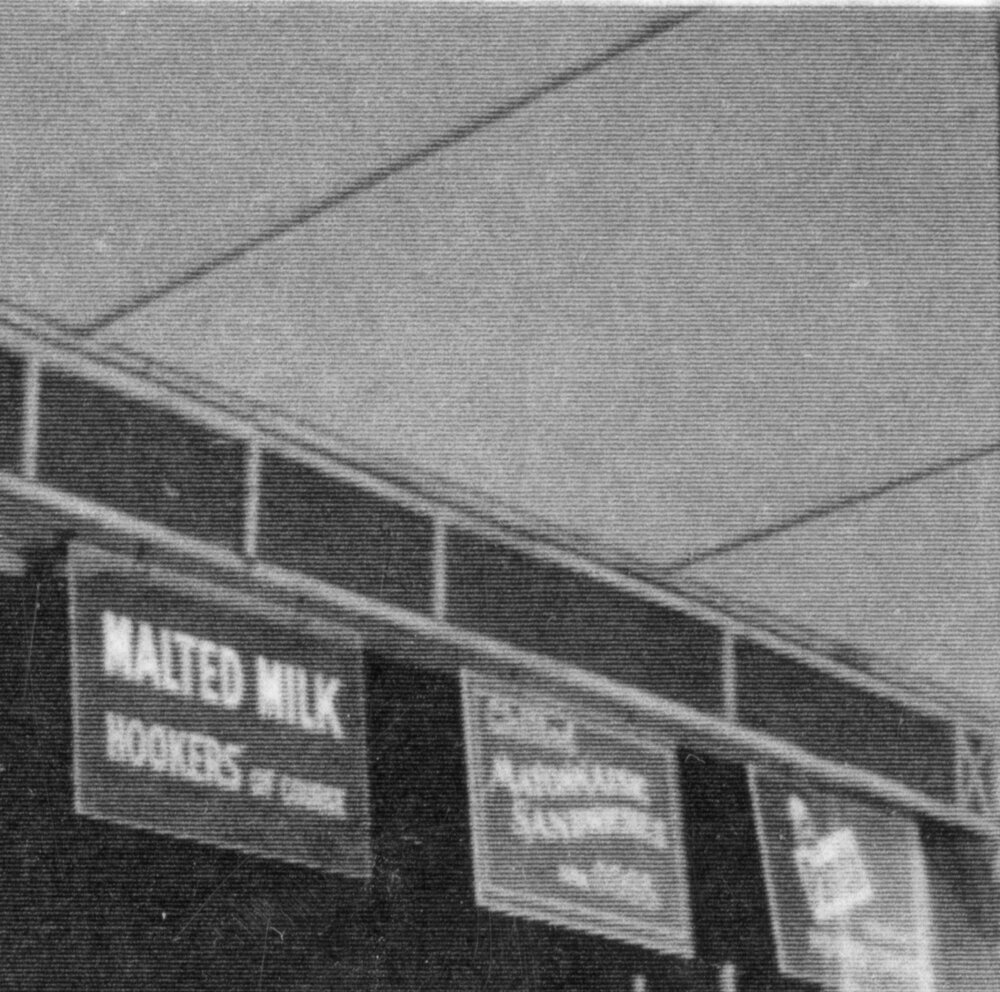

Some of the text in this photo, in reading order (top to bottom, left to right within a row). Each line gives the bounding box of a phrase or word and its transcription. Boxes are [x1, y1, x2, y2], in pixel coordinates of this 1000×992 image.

[101, 608, 346, 740] MALTED MILK
[104, 709, 248, 792] HOOKERS
